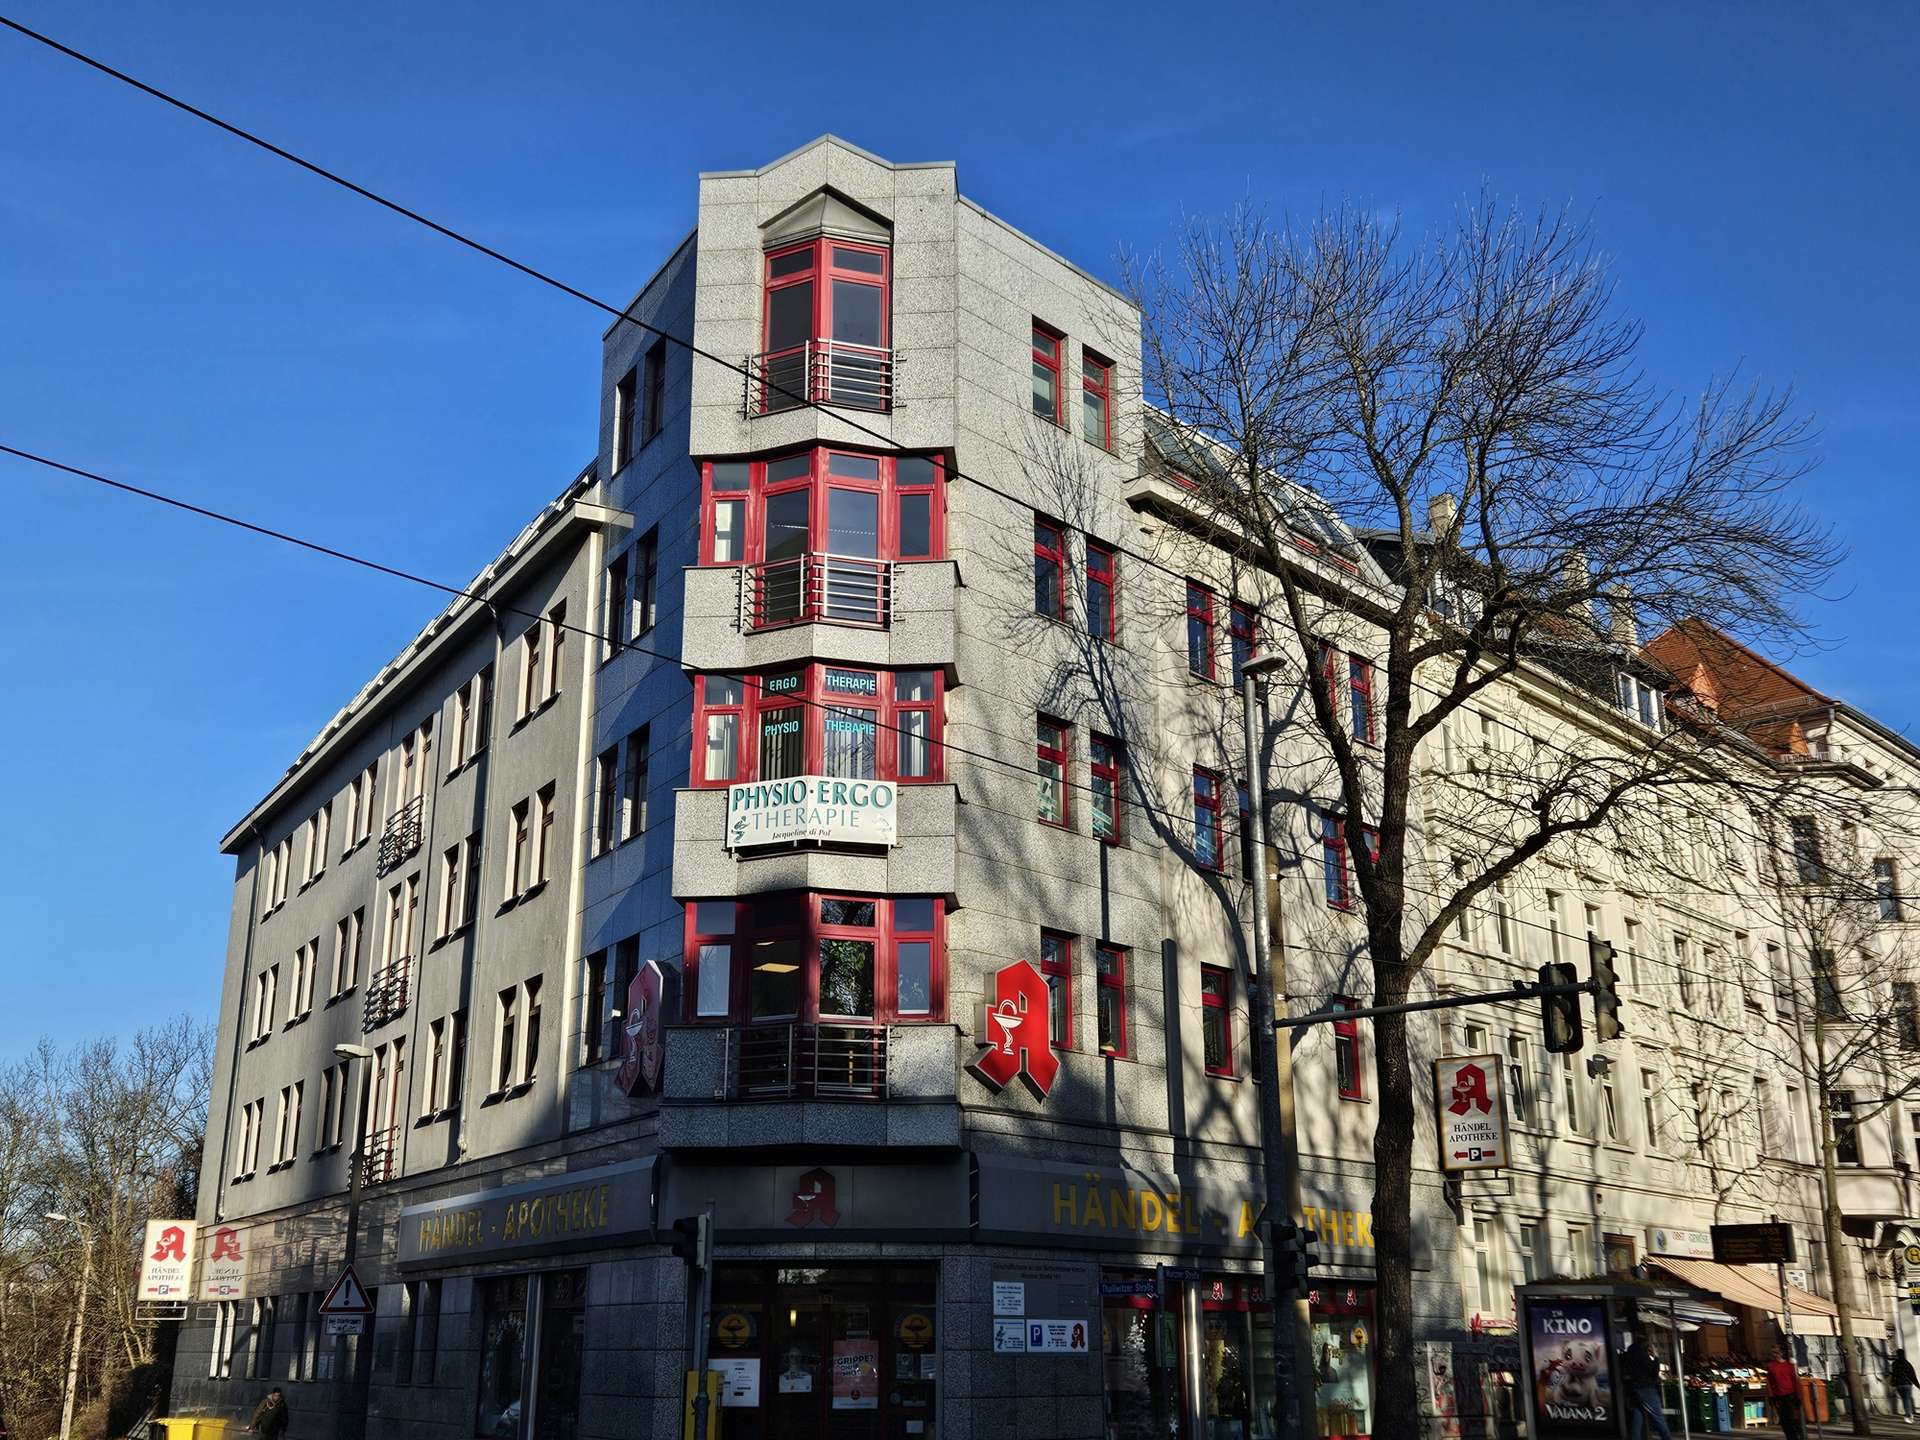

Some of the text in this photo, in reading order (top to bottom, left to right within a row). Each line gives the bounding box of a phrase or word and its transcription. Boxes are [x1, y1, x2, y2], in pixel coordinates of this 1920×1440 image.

[769, 675, 876, 692] ERGO THERAPIE
[765, 719, 875, 738] PHYSIO THERAPIE
[732, 780, 807, 813] PHYSIO
[816, 780, 893, 808] ERGO
[752, 808, 860, 830] THERAPIE
[1454, 1122, 1491, 1133] HÄNDEL
[1449, 1132, 1498, 1143] APOTHEKE
[418, 1205, 484, 1253] HÄNDEL
[503, 1185, 609, 1241] APOTHEKE
[1053, 1171, 1201, 1235] HÄNDEL
[1238, 1199, 1376, 1249] ATHEK
[1543, 1318, 1592, 1335] KINO
[1594, 1405, 1609, 1422] 2
